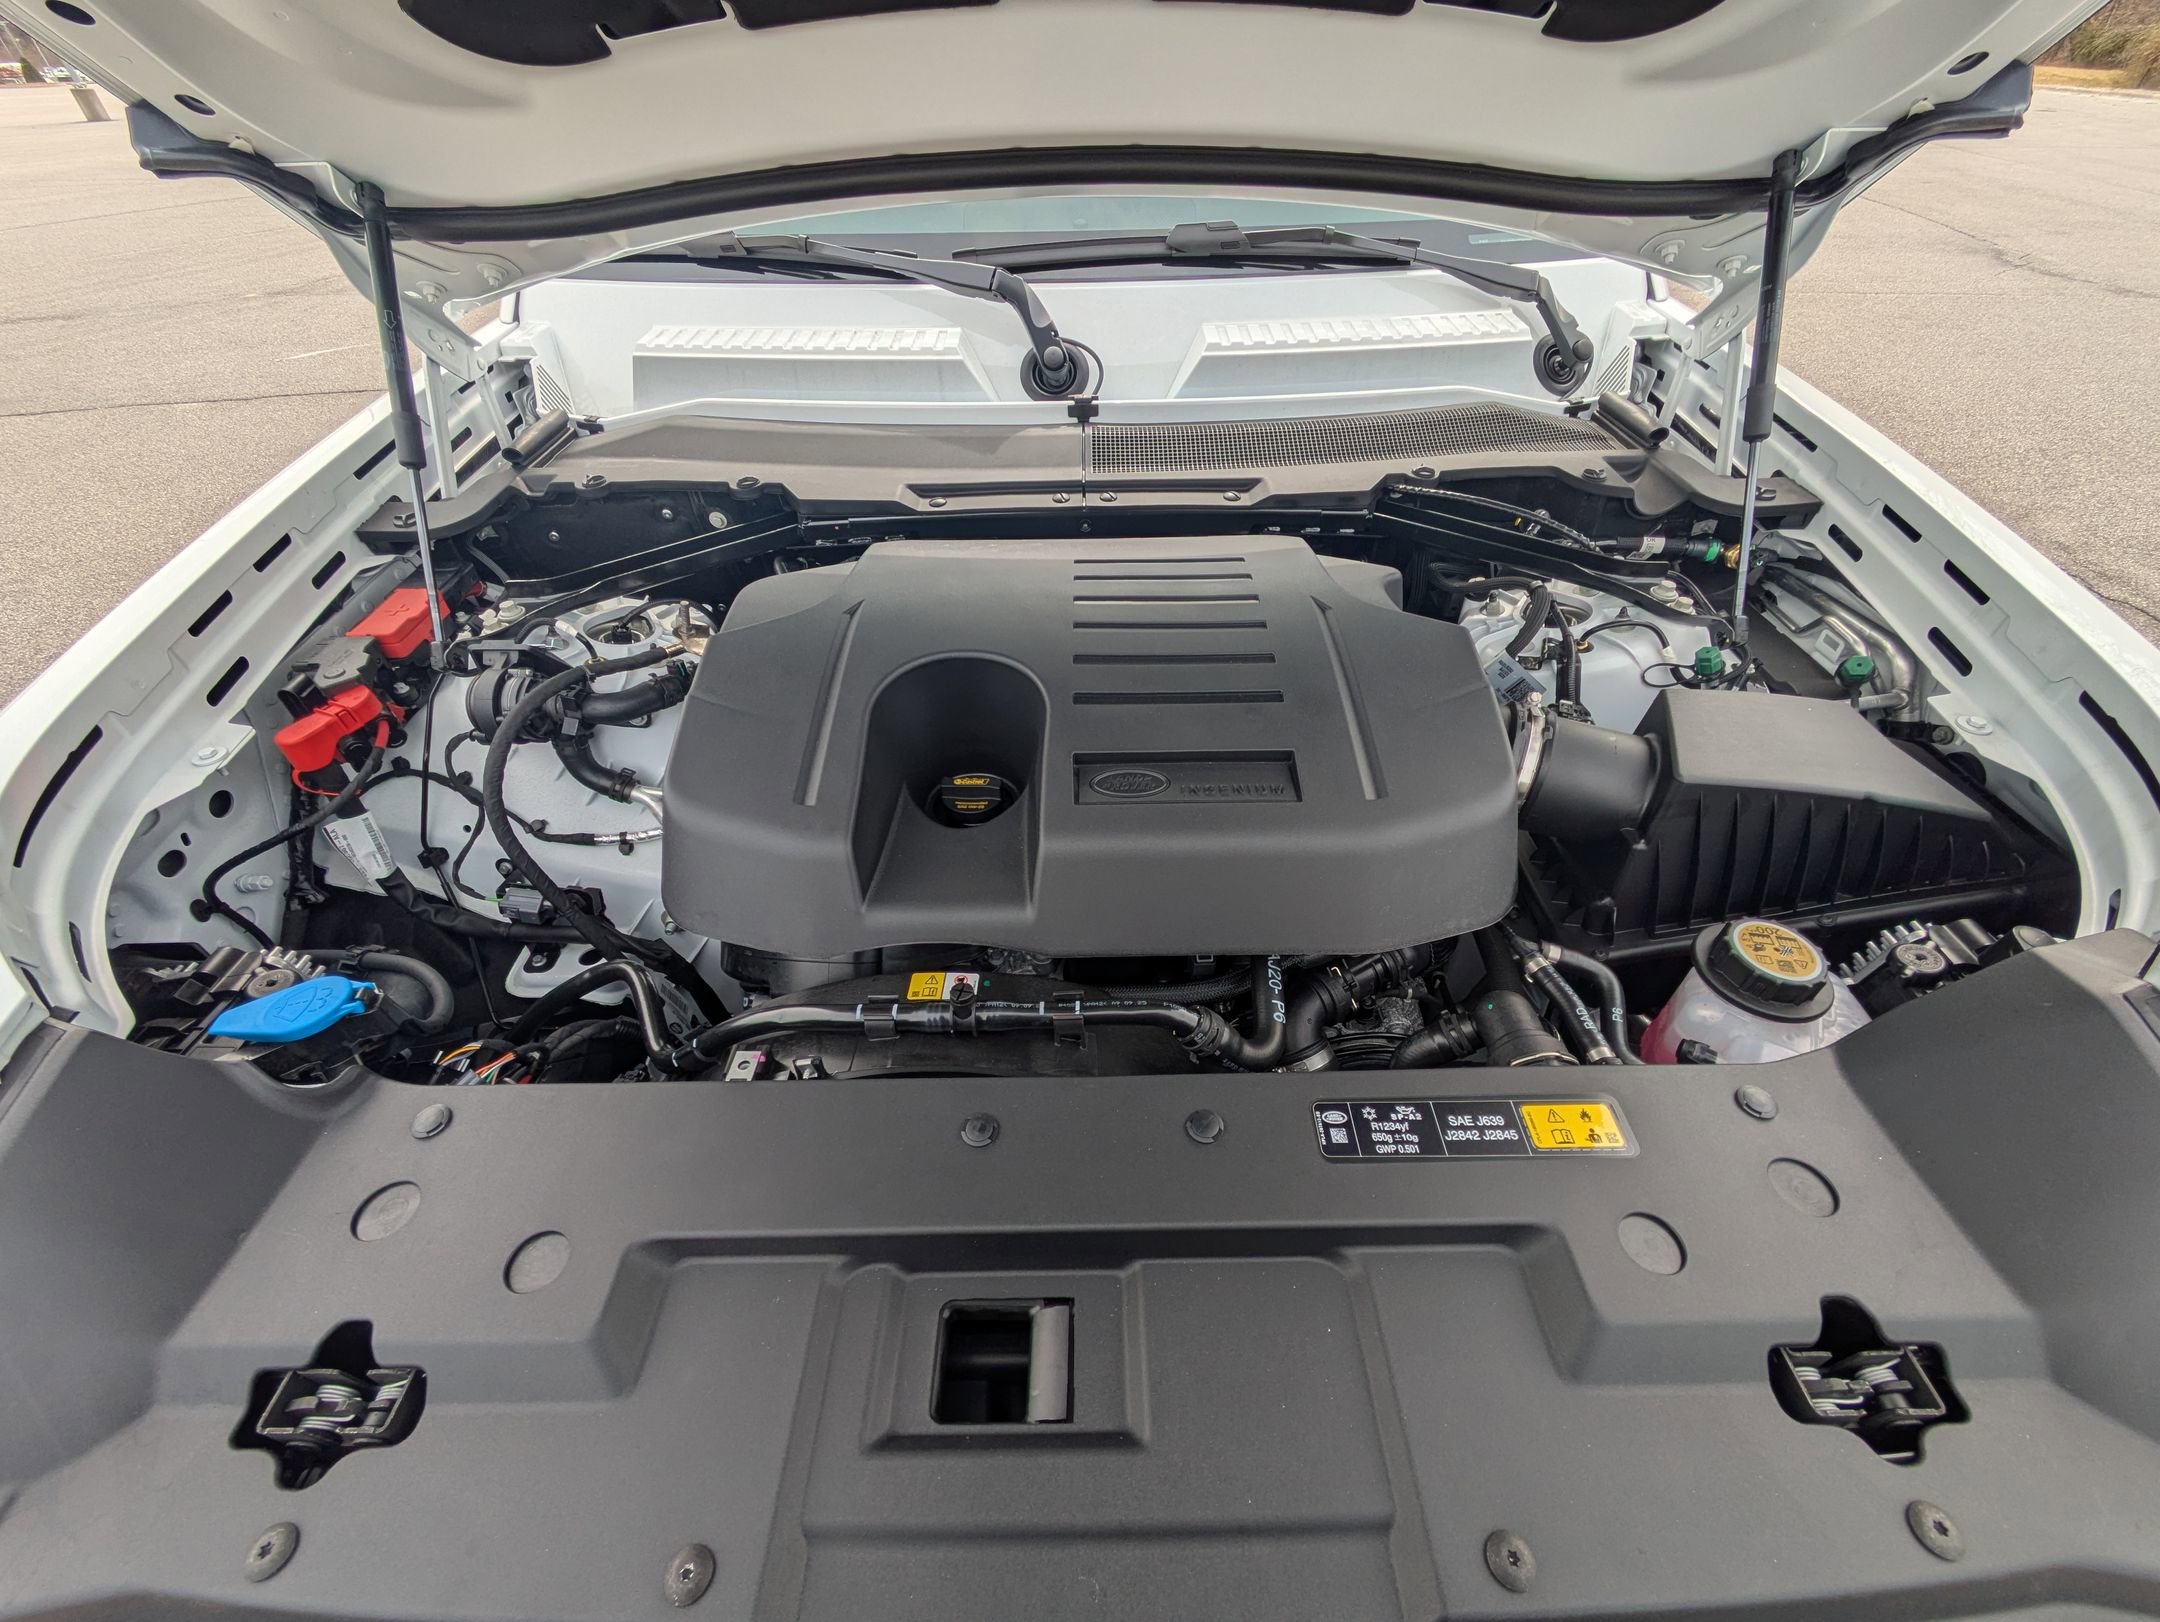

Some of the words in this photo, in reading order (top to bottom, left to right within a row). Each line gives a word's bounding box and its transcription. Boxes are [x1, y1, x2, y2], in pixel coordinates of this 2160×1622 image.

[1180, 783, 1286, 797] INGENIUM
[1612, 1007, 1624, 1023] P6
[1448, 1115, 1475, 1126] SAE
[1476, 1115, 1505, 1126] J639
[1371, 1122, 1409, 1132] R1234yf
[1371, 1132, 1393, 1143] 650g
[1444, 1130, 1481, 1141] J2842
[1483, 1129, 1519, 1140] J2845
[1376, 1144, 1397, 1154] GWP
[1397, 1144, 1420, 1154] 0.501
